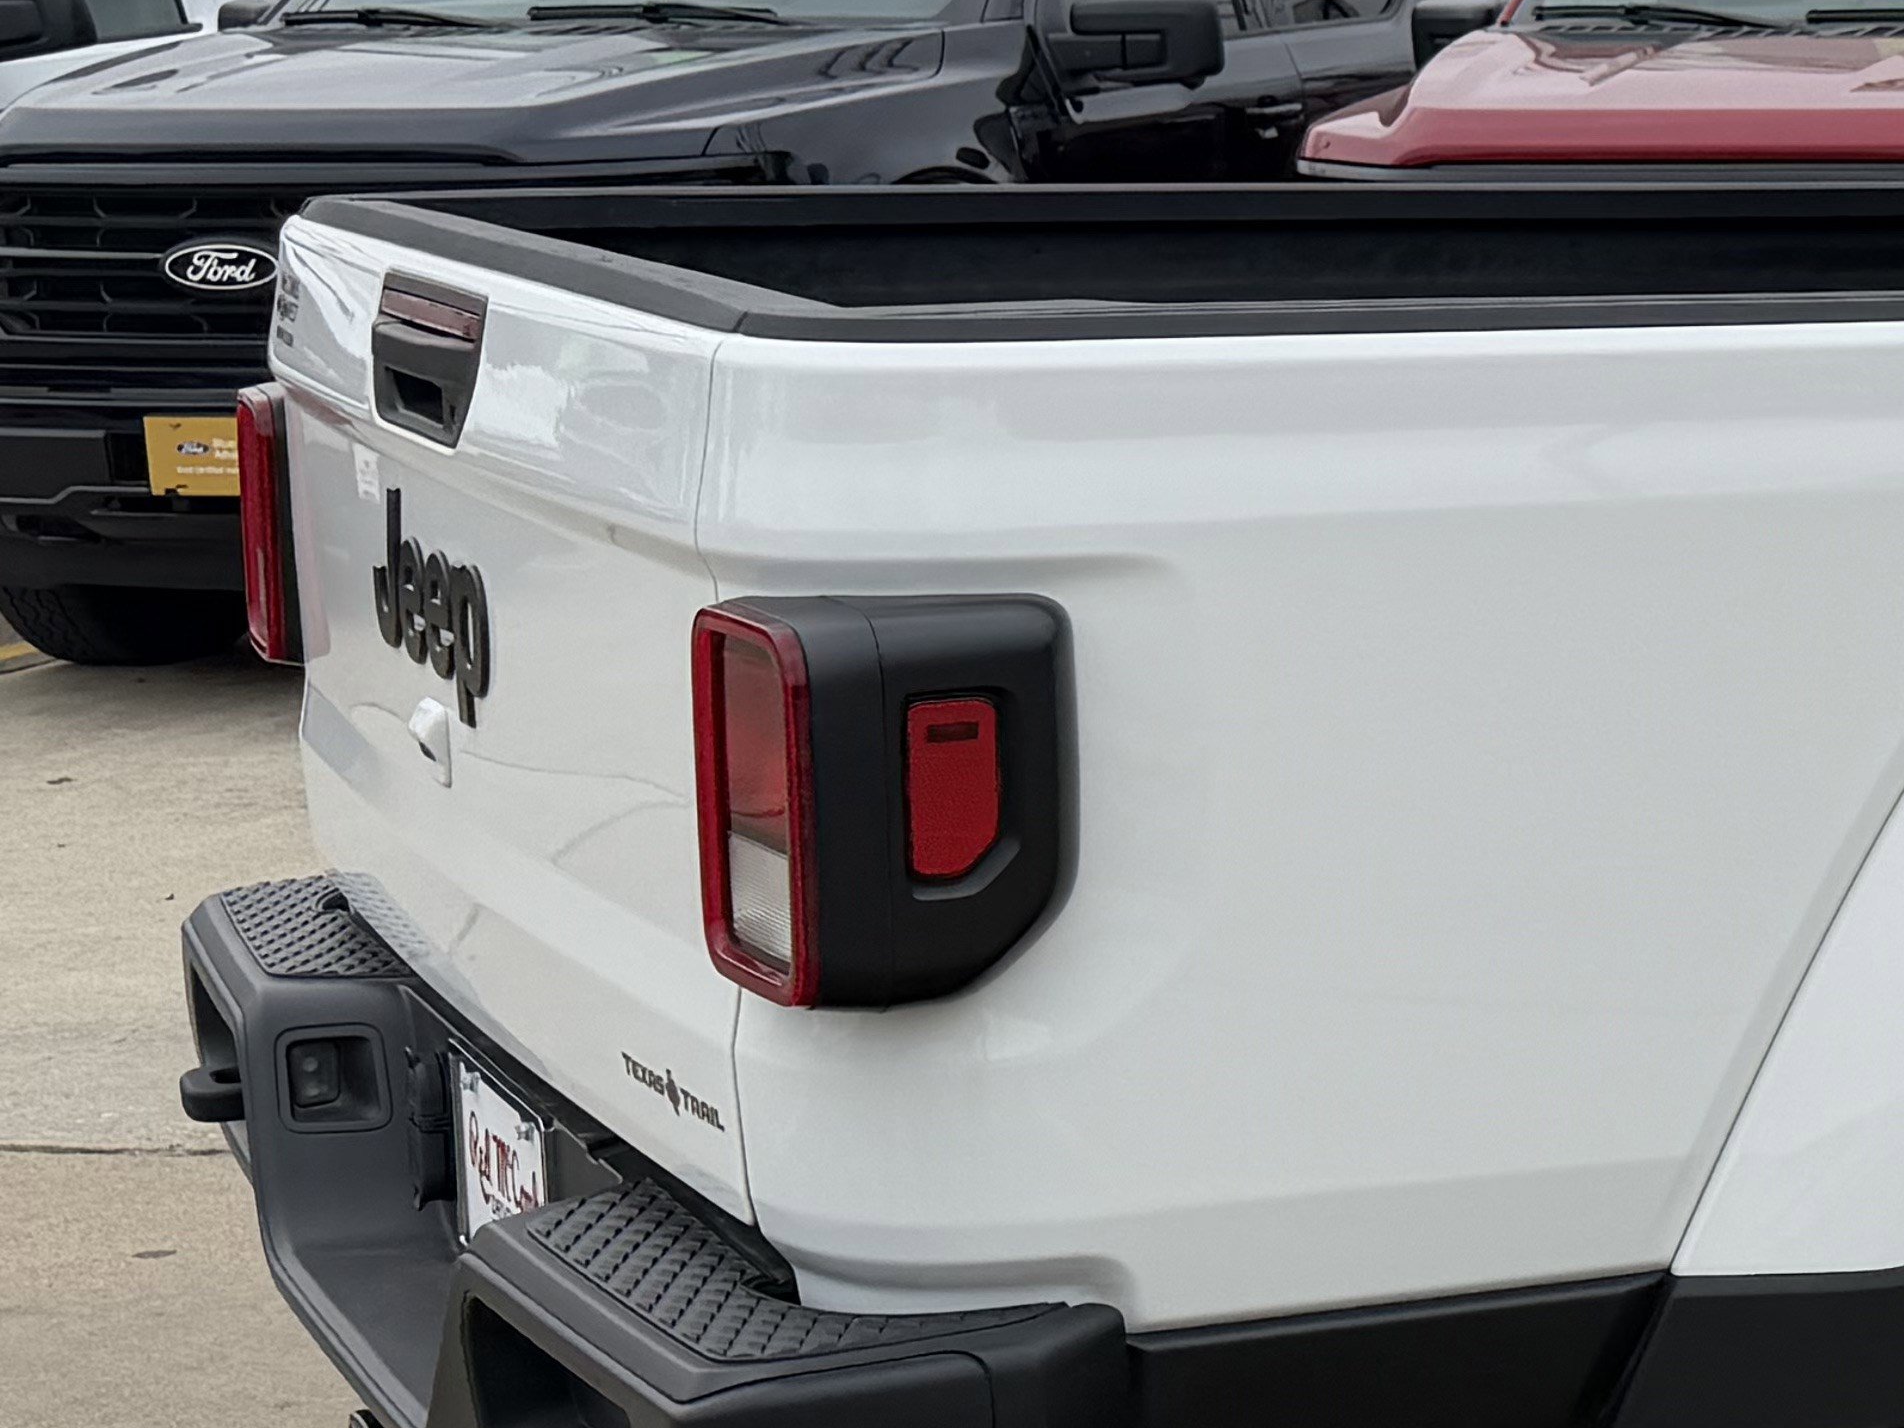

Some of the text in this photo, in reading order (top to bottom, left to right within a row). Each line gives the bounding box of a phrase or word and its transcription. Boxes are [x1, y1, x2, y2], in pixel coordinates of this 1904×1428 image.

[186, 250, 258, 282] Ford
[372, 487, 490, 729] Jeep
[621, 1051, 725, 1132] TEXAS TRAIL
